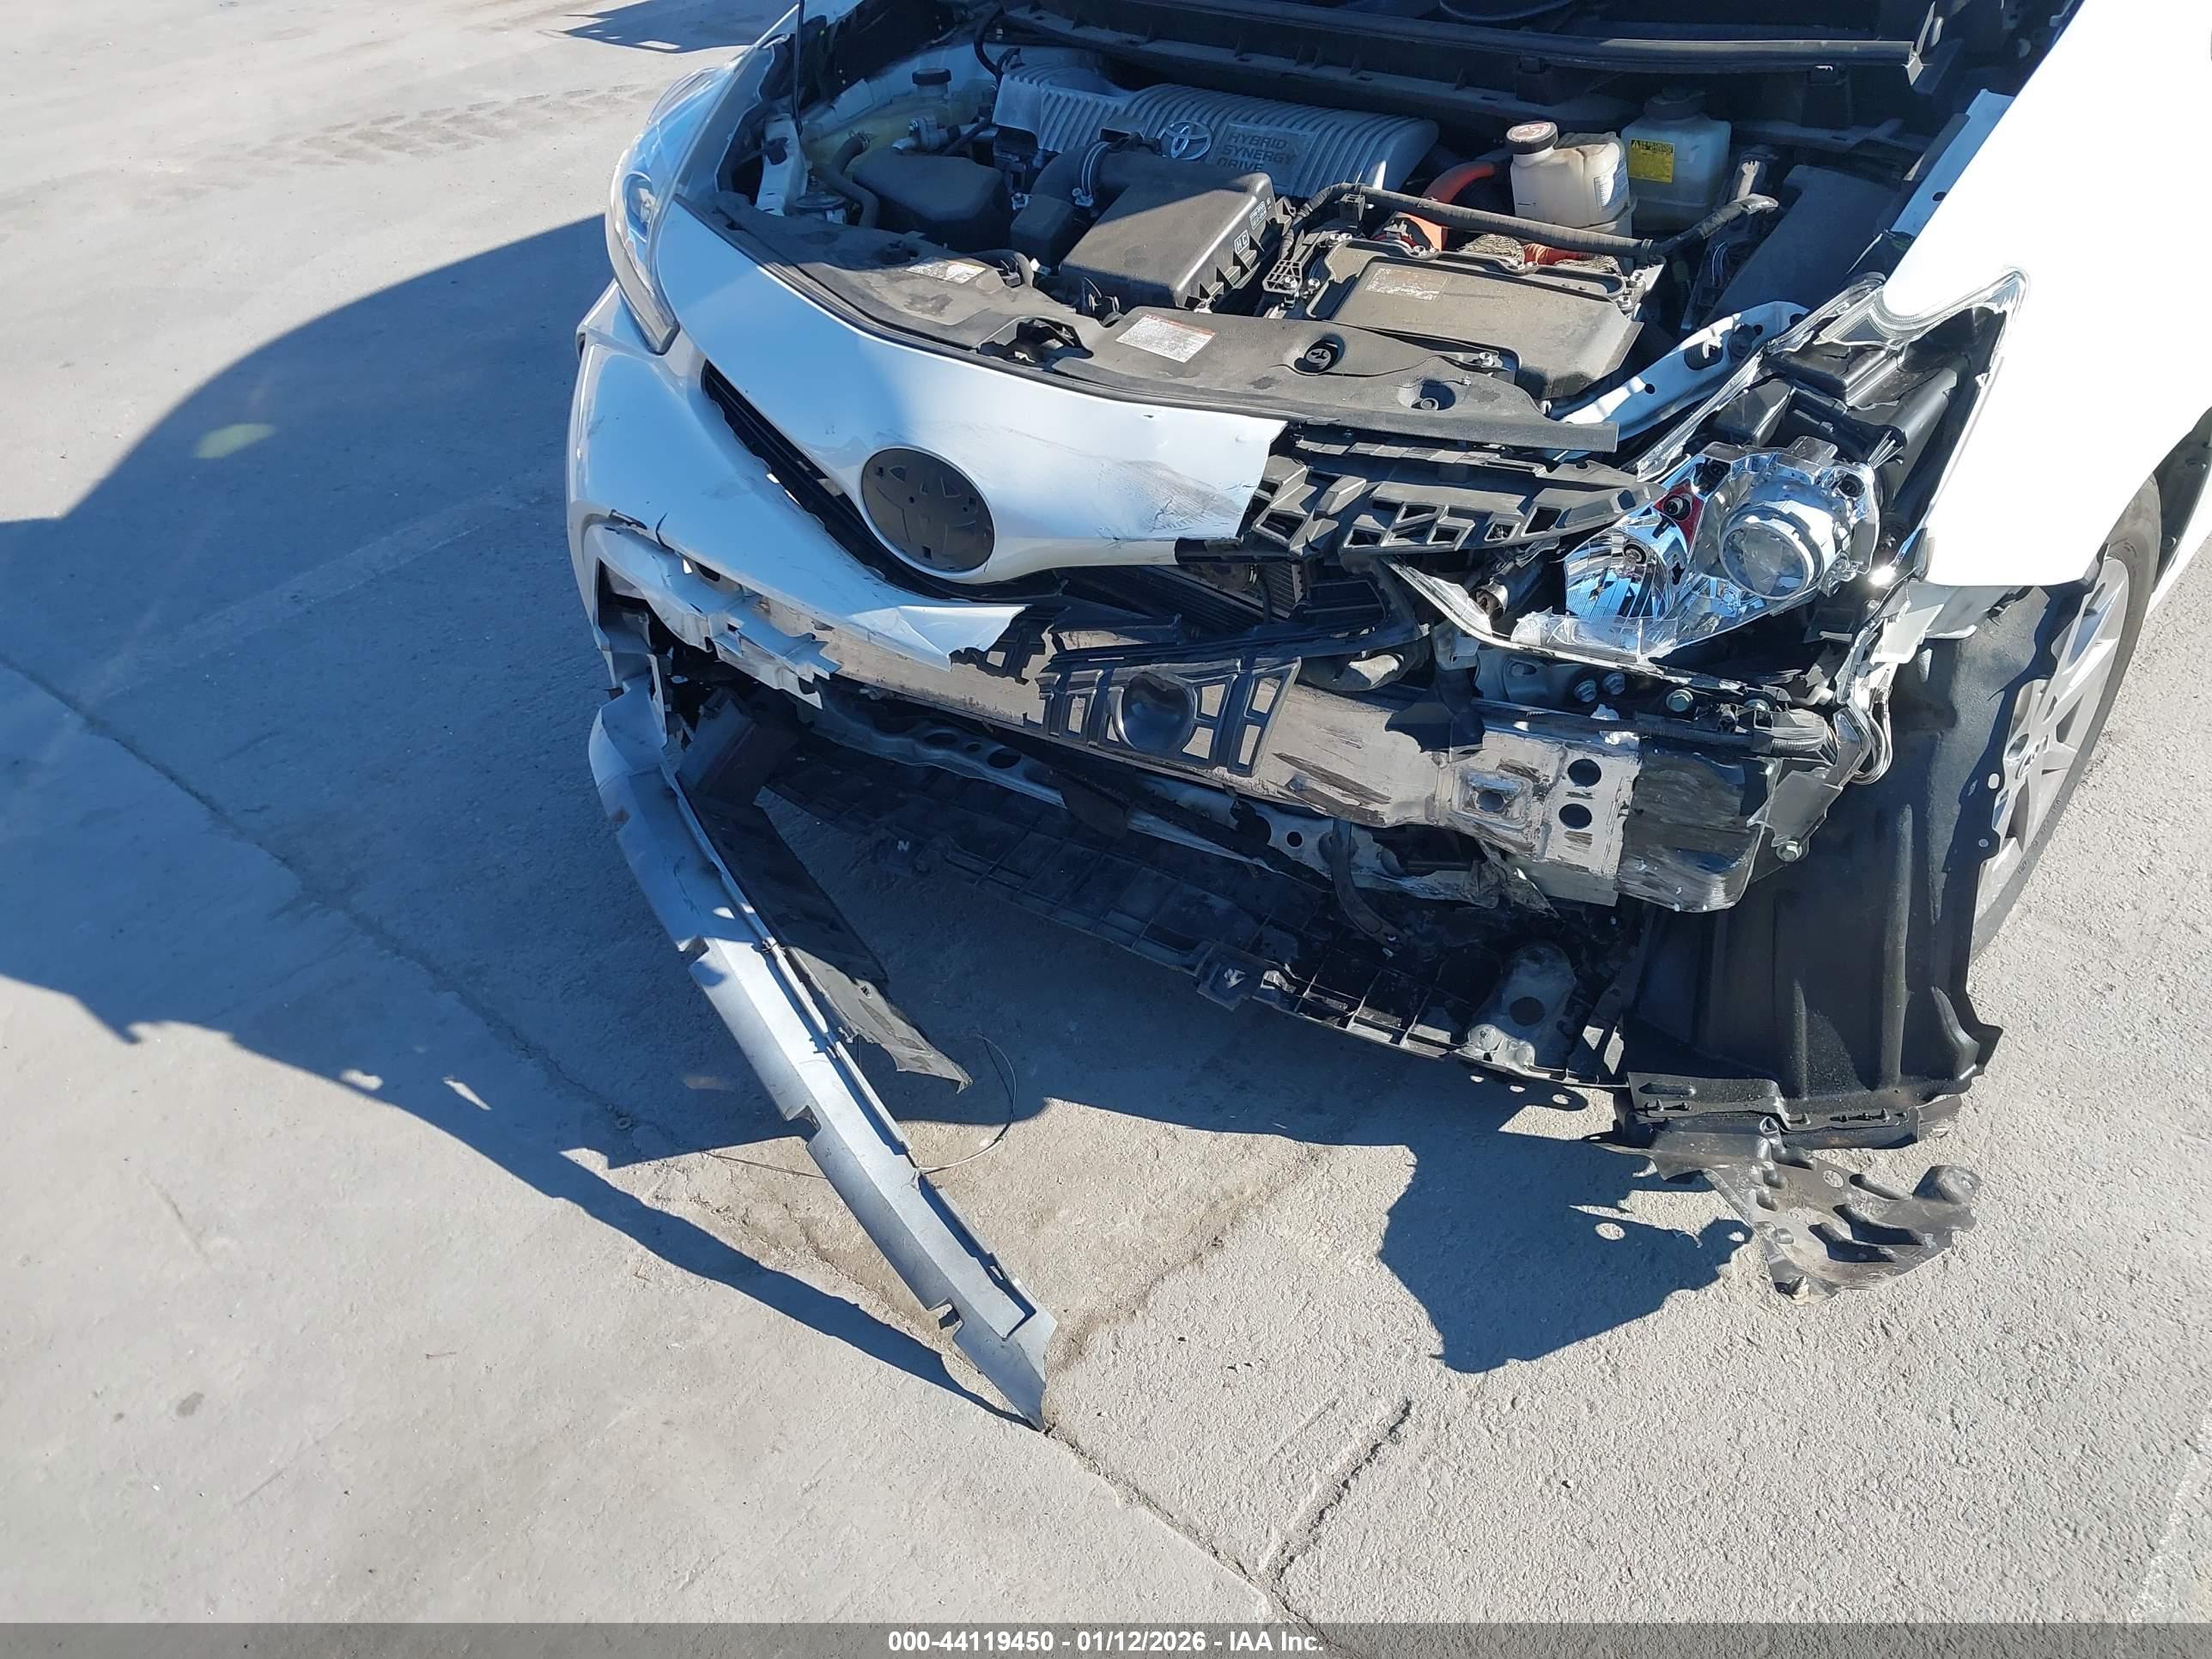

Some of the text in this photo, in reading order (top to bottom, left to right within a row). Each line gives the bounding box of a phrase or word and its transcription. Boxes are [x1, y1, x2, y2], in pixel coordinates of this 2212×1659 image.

[1228, 132, 1287, 150] HYBRID
[1221, 144, 1299, 165] SYNERGY
[1216, 158, 1264, 171] DRIVE
